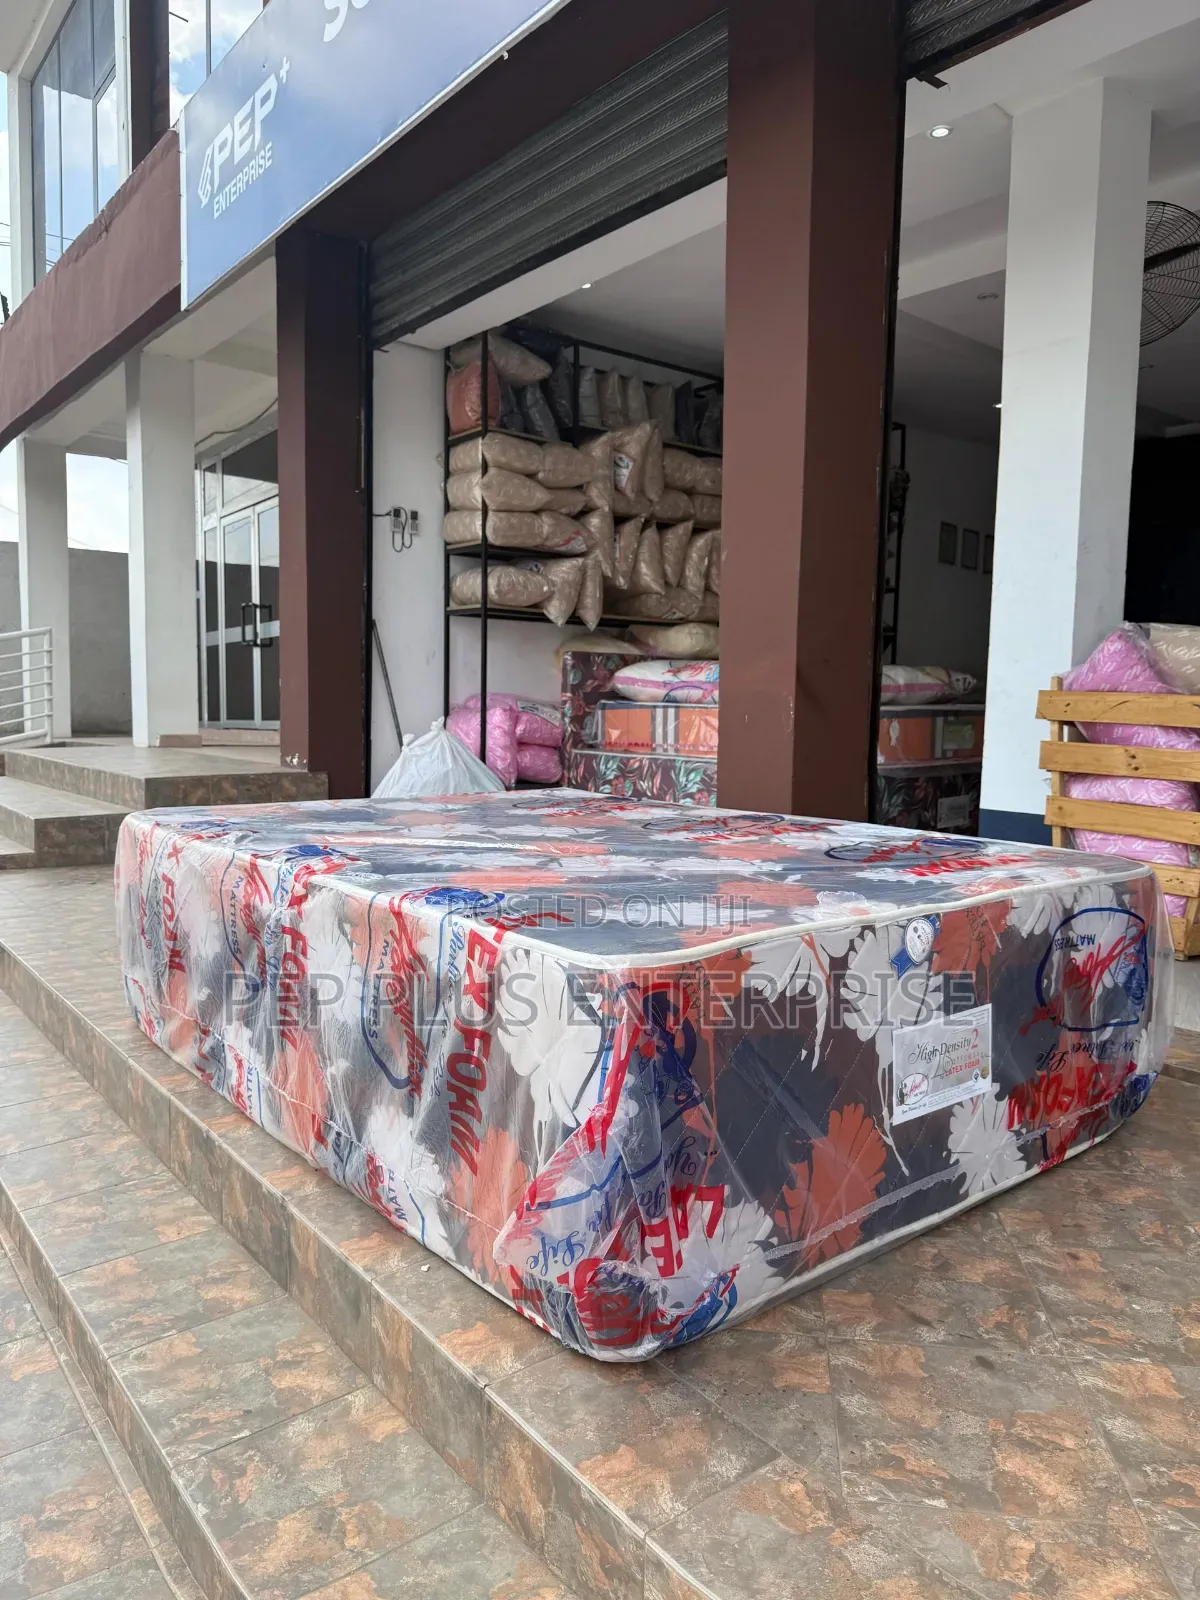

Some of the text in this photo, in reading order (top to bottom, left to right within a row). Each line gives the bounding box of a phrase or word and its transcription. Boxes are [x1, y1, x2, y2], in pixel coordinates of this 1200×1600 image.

[213, 141, 273, 220] ENTERPRISE
[229, 874, 245, 955] MATTRESS
[1053, 932, 1097, 952] MATTRESS
[368, 938, 391, 1041] MATTRESS
[446, 1015, 493, 1177] FOAM
[526, 1230, 587, 1278] Life
